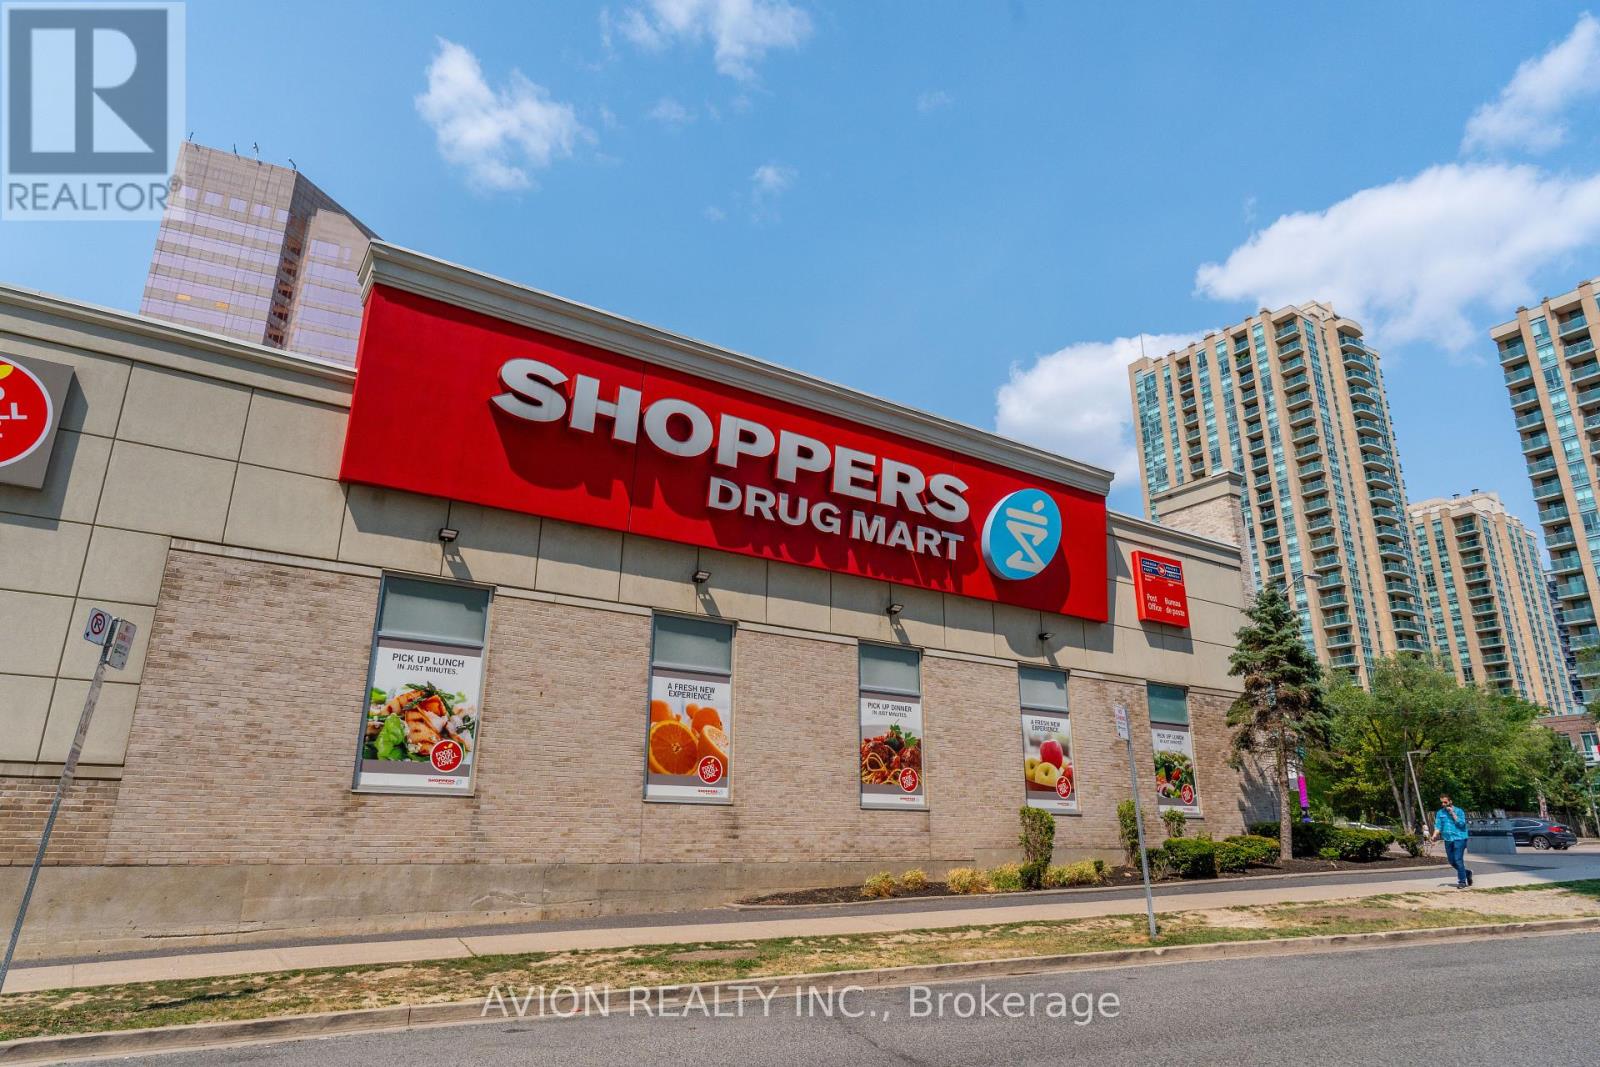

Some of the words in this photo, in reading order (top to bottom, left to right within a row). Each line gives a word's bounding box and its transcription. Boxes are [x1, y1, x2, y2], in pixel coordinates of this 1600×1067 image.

[490, 357, 970, 523] SHOPPERS
[708, 476, 841, 534] DRUG
[851, 509, 965, 561] MART
[1146, 593, 1158, 602] Post
[1147, 602, 1163, 612] Office
[392, 652, 414, 662] PICK
[417, 655, 431, 664] UP
[432, 656, 465, 668] LUNCH
[406, 664, 424, 672] JUST
[667, 682, 673, 690] A
[674, 683, 698, 692] FRESH
[699, 685, 716, 694] NEW
[668, 690, 715, 701] EXPERIENCE.
[867, 702, 881, 710] PICK
[891, 704, 913, 713] DINNER
